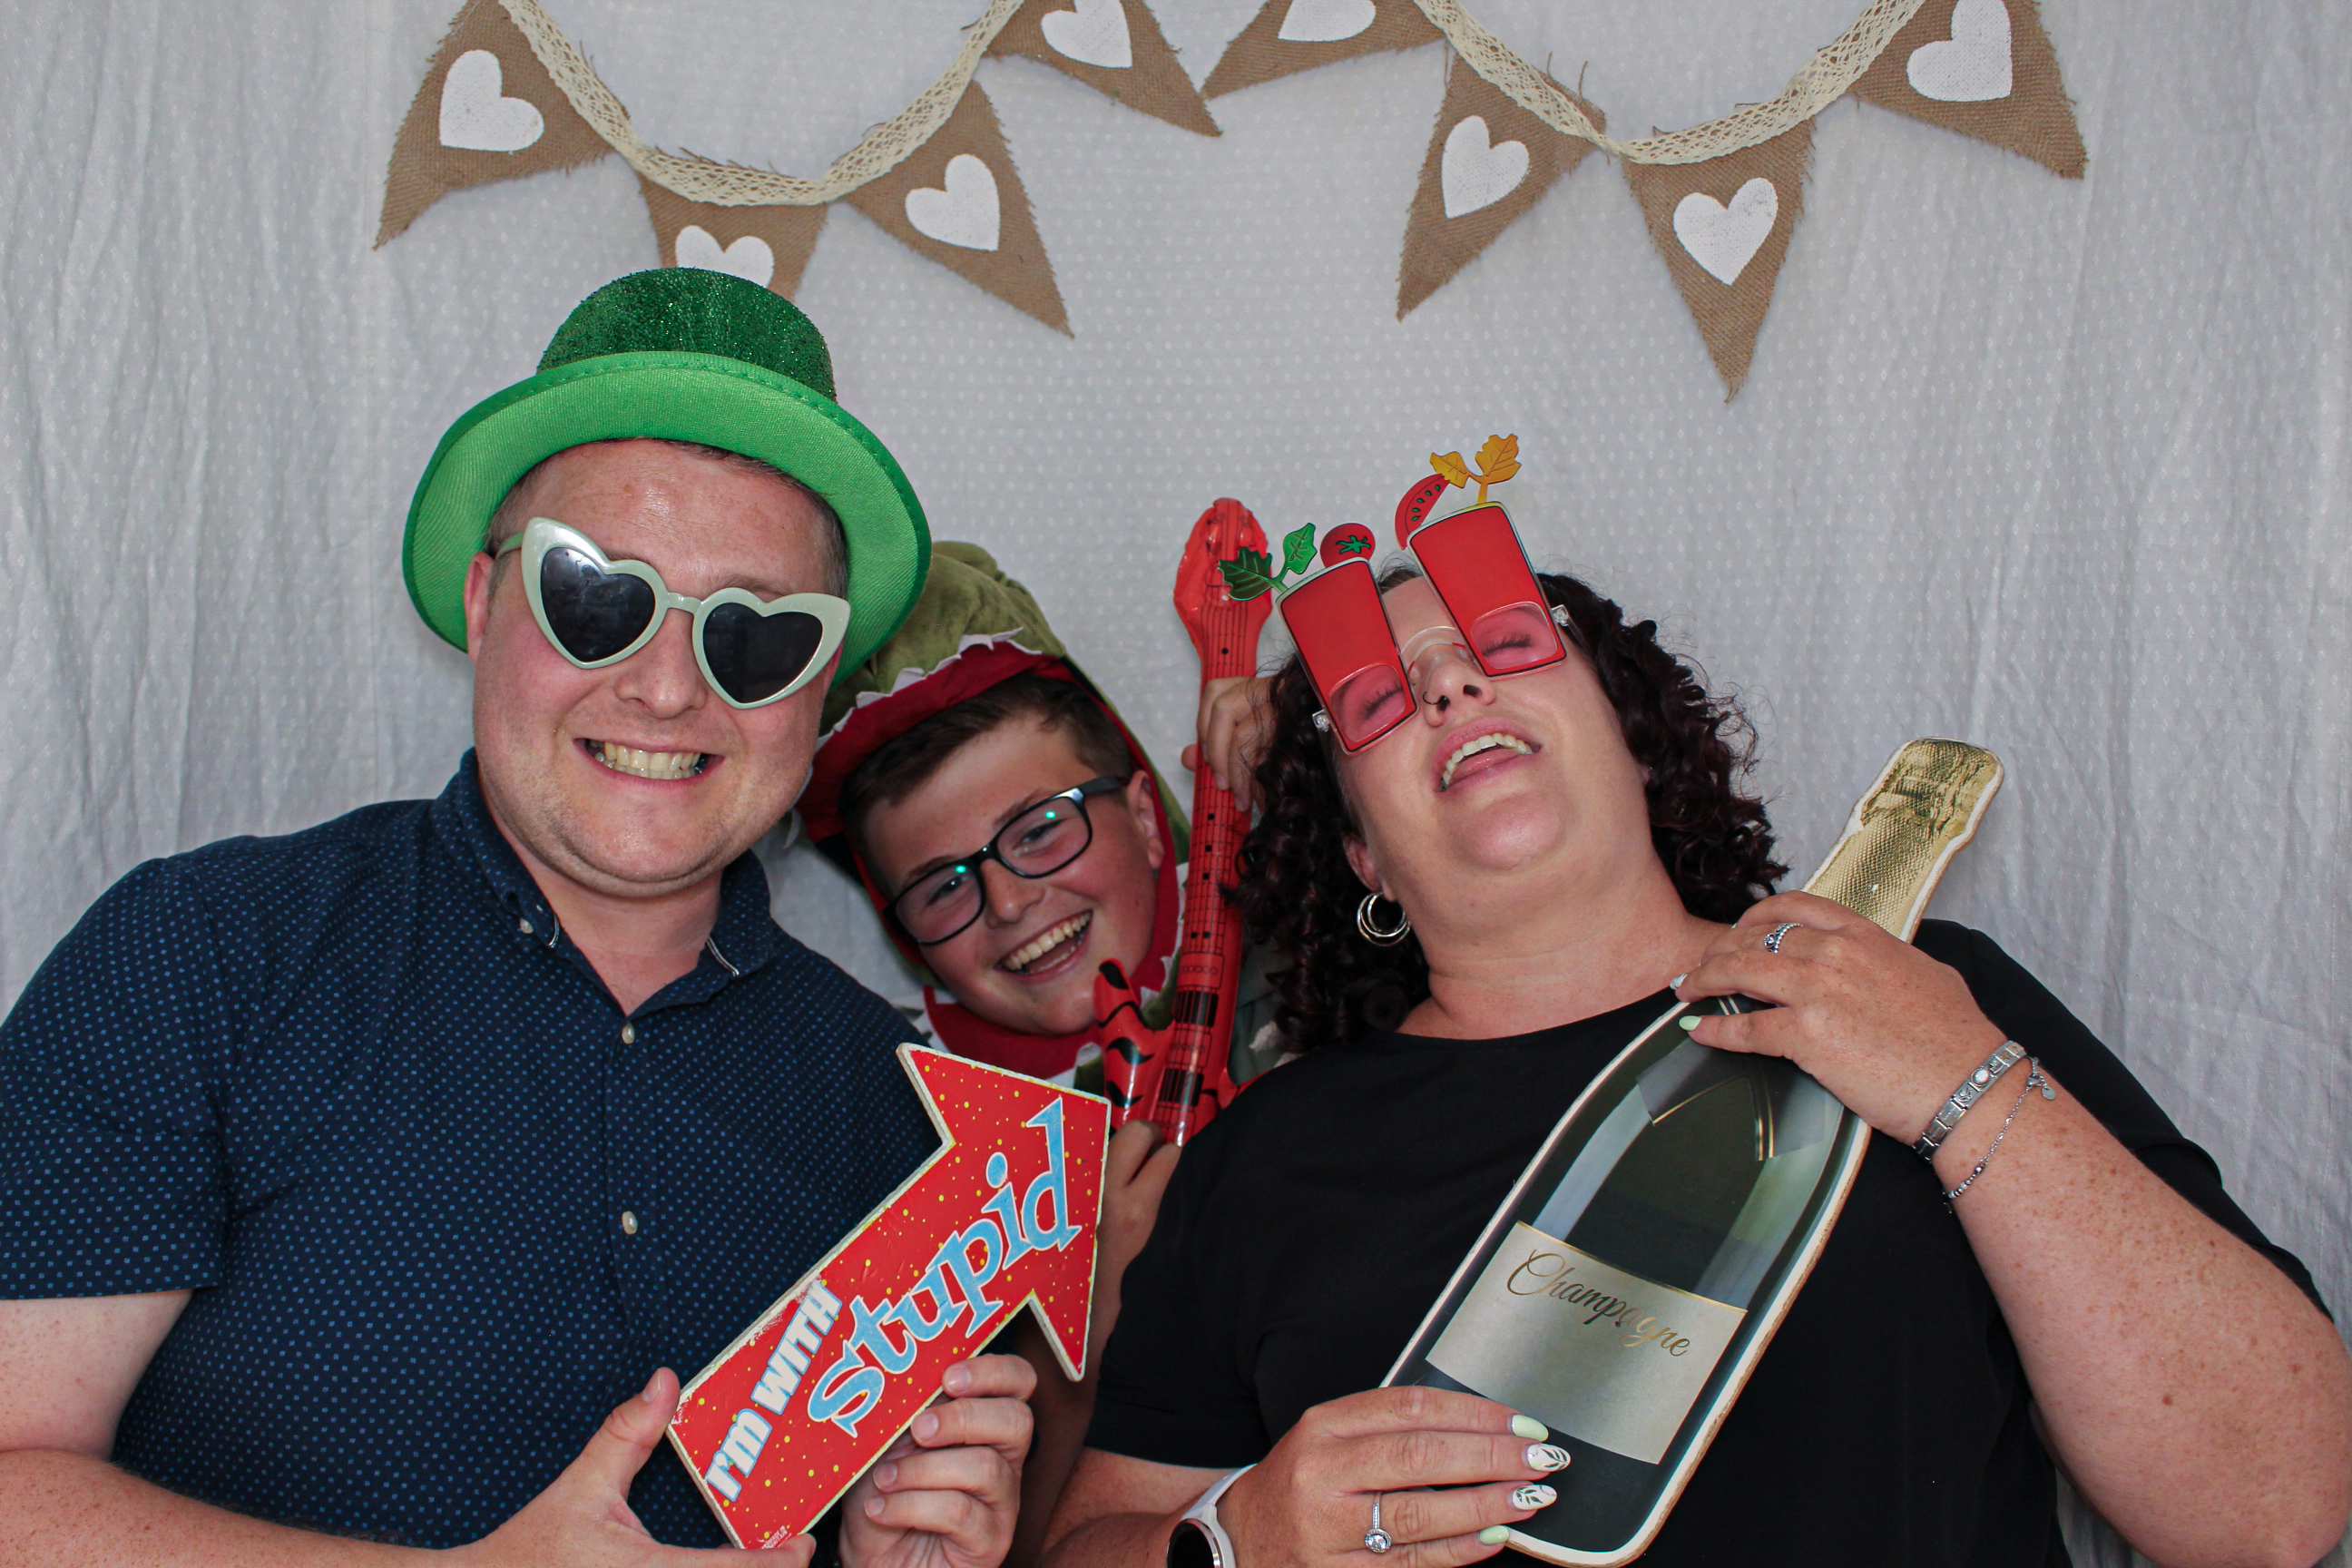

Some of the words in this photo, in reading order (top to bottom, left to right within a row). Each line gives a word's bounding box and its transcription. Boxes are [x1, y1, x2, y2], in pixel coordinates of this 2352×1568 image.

[808, 1097, 1083, 1438] stupid
[1506, 1249, 1690, 1357] Champagne
[750, 1279, 843, 1415] WITH
